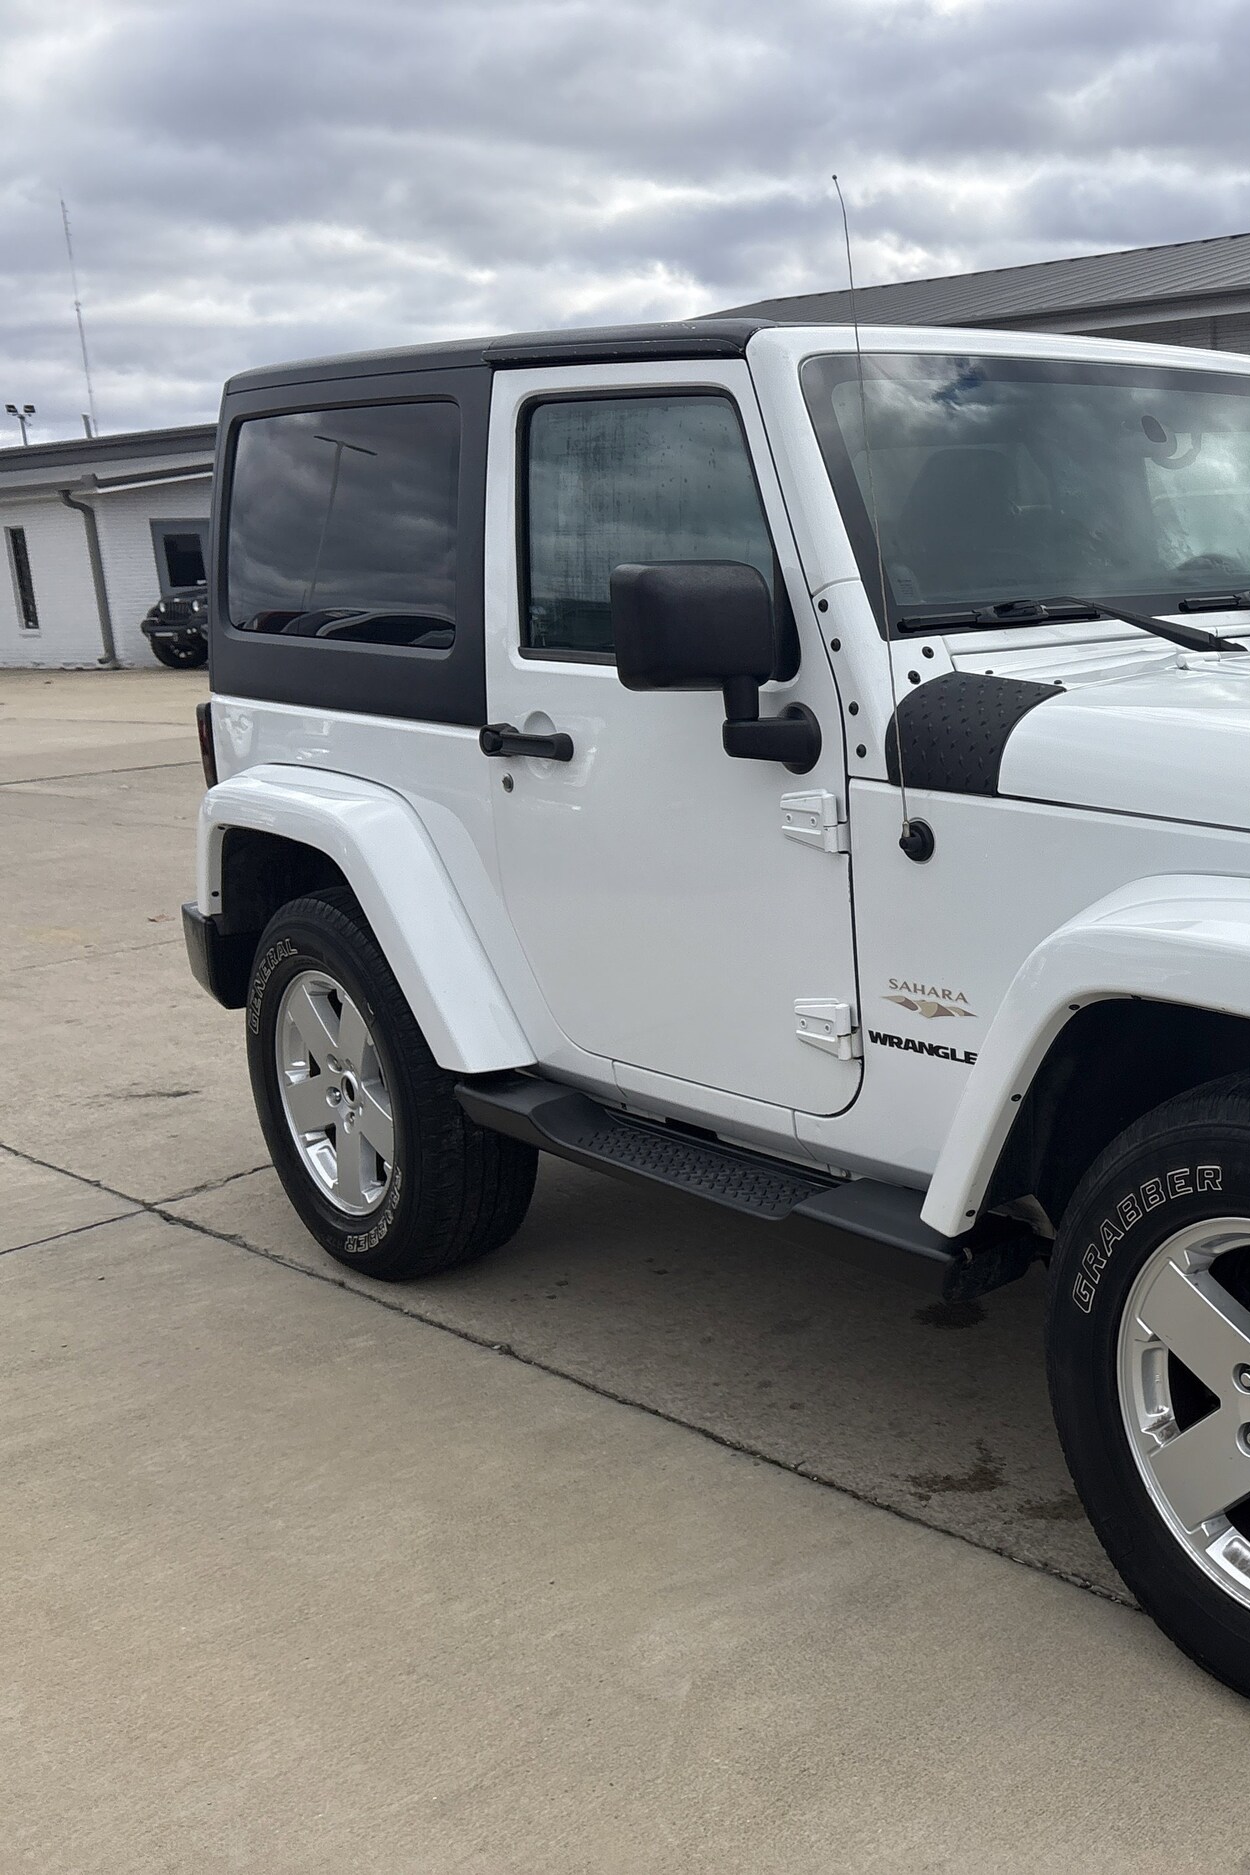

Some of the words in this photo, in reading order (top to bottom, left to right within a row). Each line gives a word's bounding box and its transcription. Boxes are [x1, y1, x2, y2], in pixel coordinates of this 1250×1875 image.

[248, 938, 299, 1036] GENERAL
[888, 978, 970, 1004] SAHARA
[867, 1029, 979, 1066] WRANGLE
[1072, 1164, 1224, 1314] GRABBER
